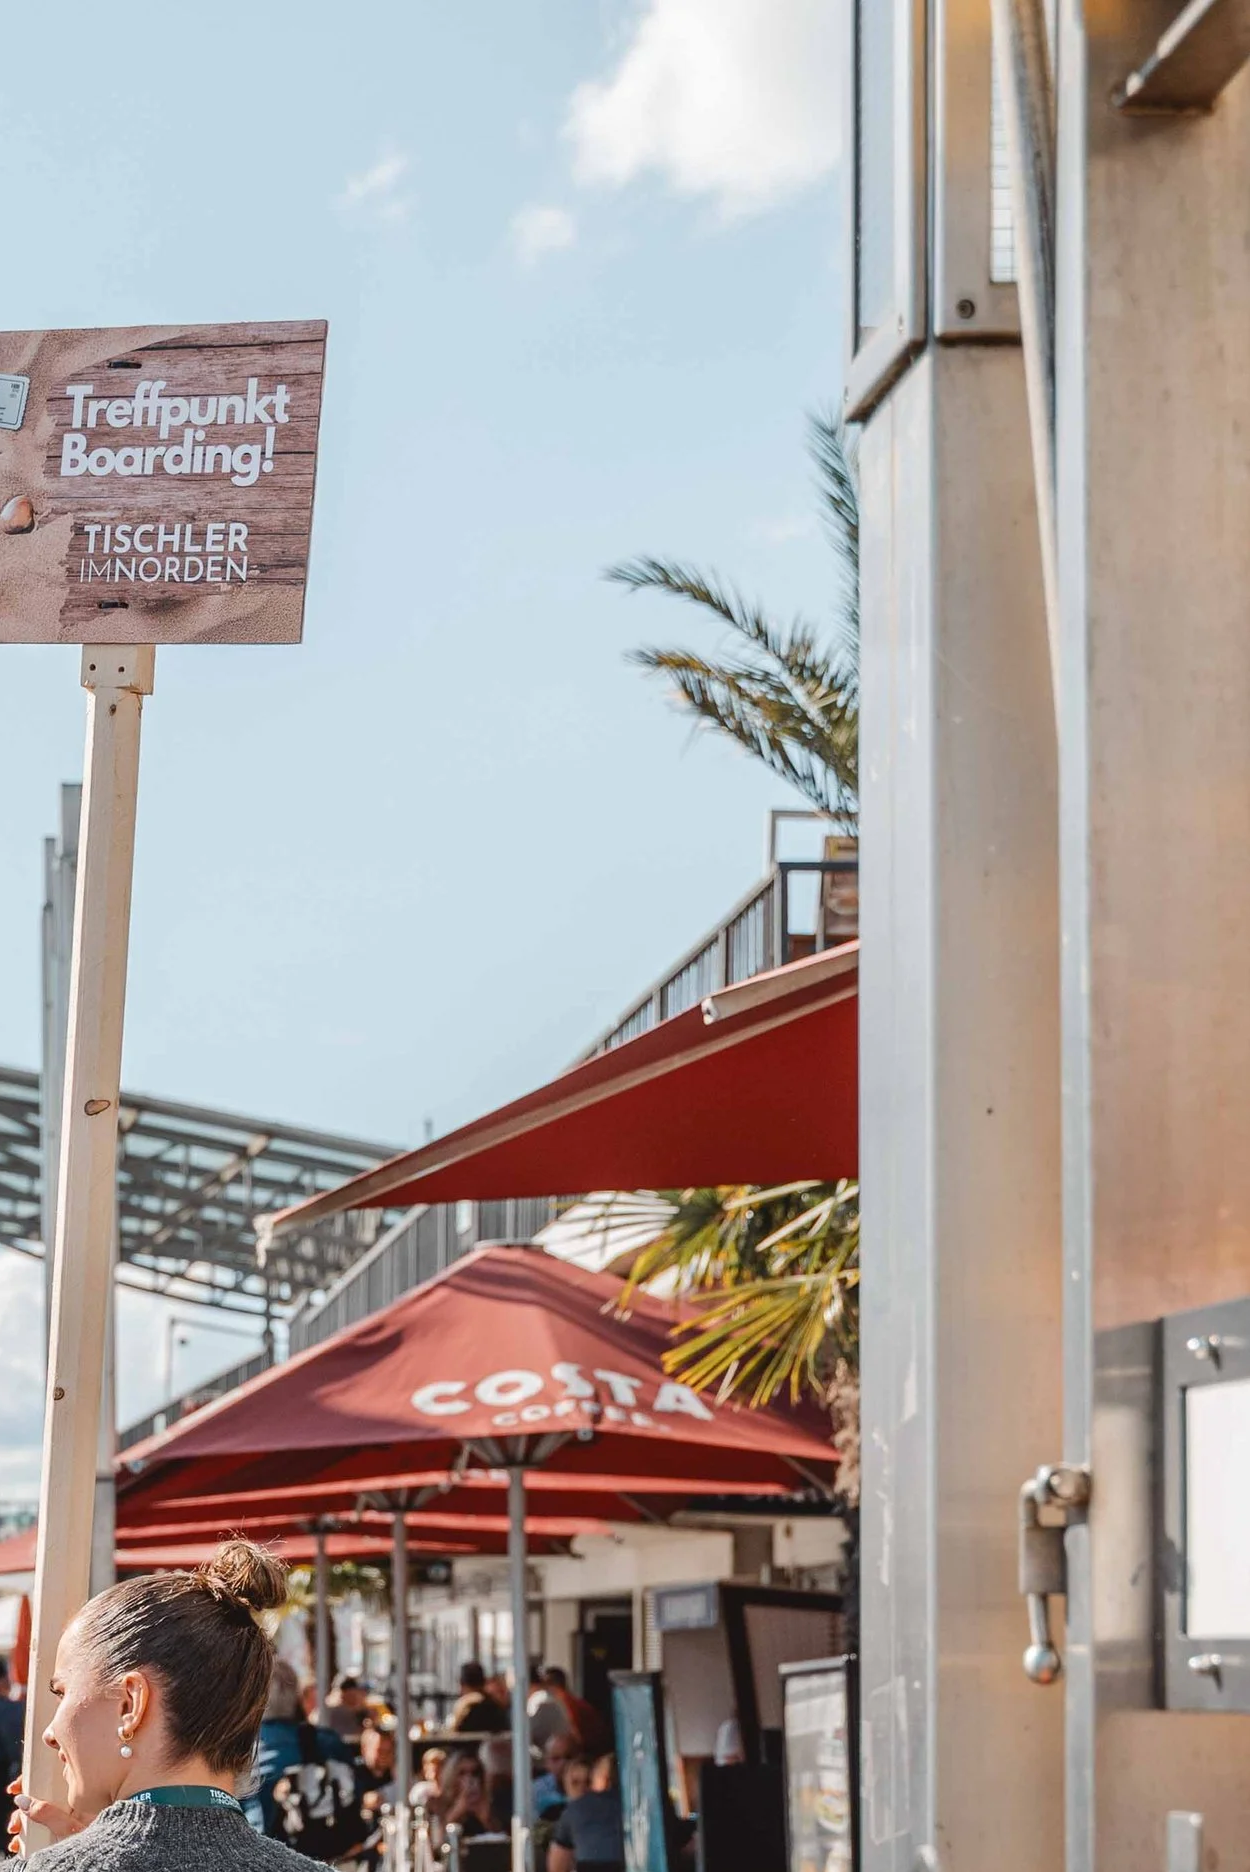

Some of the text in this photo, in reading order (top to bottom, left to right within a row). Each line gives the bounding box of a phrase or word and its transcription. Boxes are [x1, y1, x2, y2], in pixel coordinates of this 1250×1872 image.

[66, 377, 291, 440] Treffpunkt
[60, 426, 276, 487] Boarding!
[83, 522, 249, 554] TISCHLER
[79, 555, 249, 583] IMNORDEN
[411, 1361, 715, 1421] COSTA
